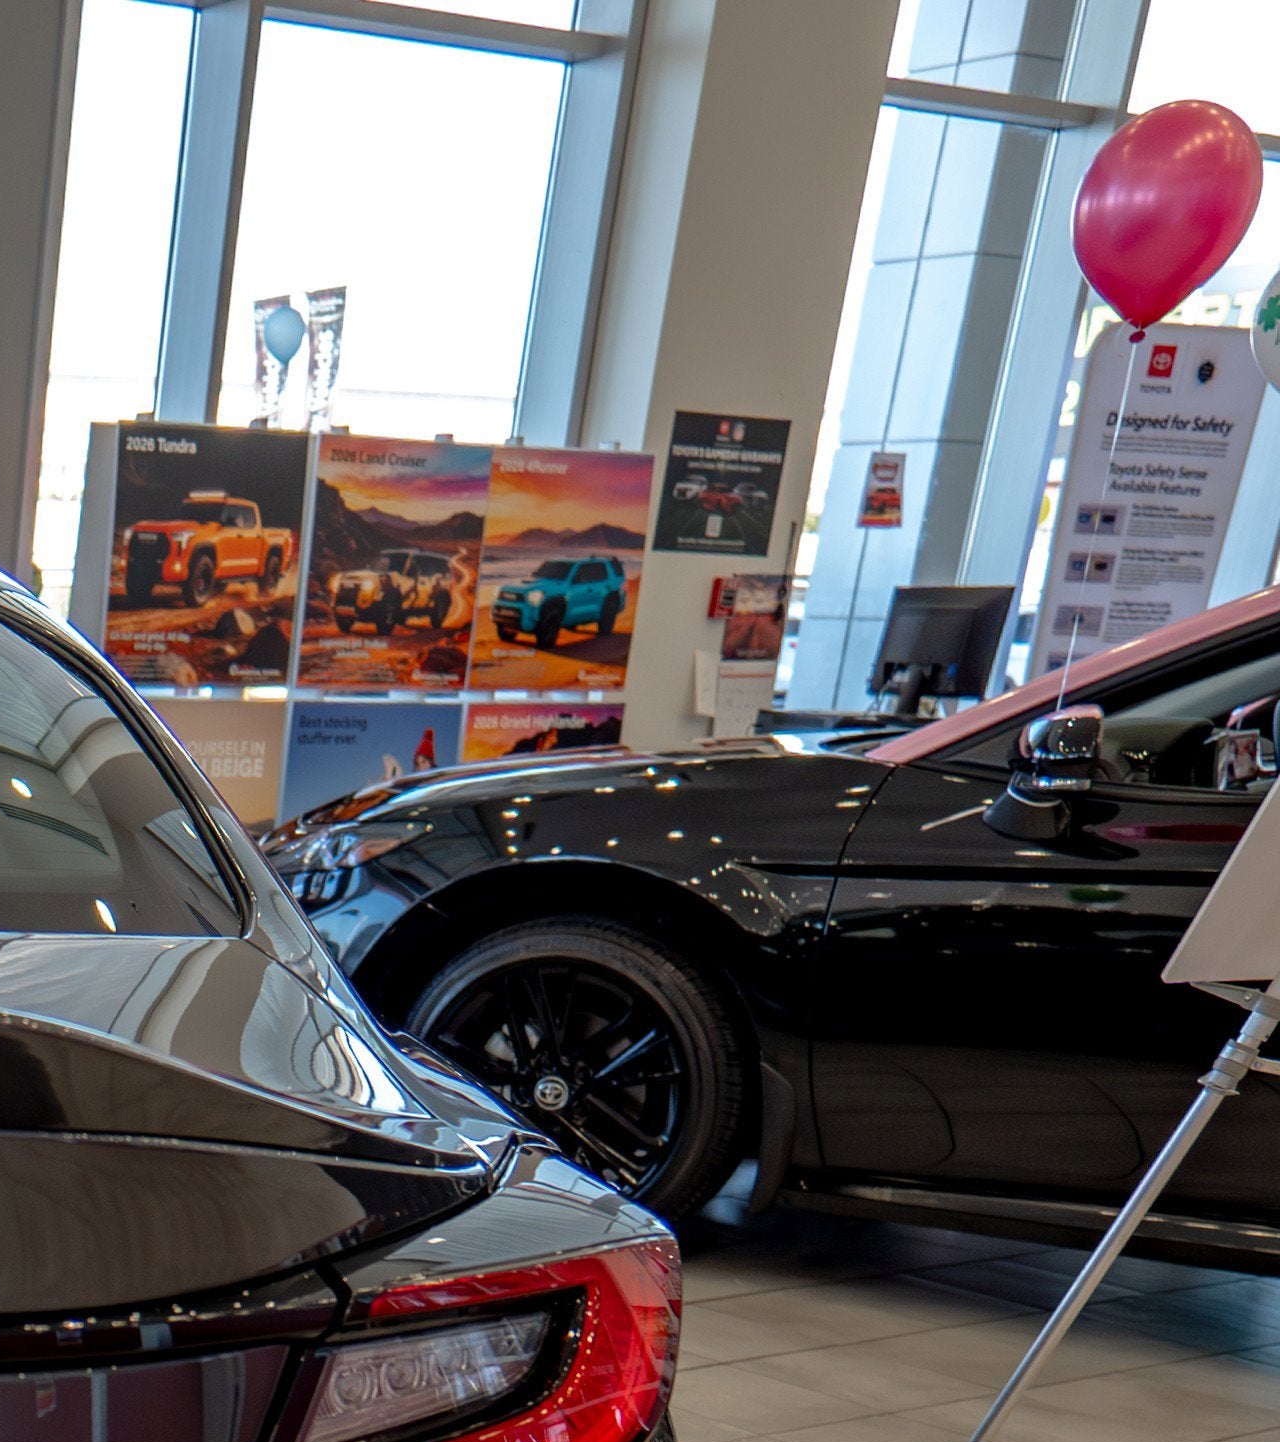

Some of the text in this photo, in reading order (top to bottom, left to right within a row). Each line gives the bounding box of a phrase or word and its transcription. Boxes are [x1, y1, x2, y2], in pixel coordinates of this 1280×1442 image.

[1171, 415, 1190, 431] for
[1191, 417, 1234, 437] Safety
[125, 436, 197, 455] 2026 Tundra
[358, 451, 386, 465] Land
[389, 453, 428, 468] Cruiser
[1110, 462, 1208, 480] Toyota Safety Sense
[1109, 480, 1201, 497] Available Features
[298, 715, 367, 733] Best stocking
[473, 715, 587, 733] 2026 Grand Highlander
[251, 740, 266, 755] IN
[298, 731, 331, 746] stuffer
[211, 757, 264, 778] BEIGE
